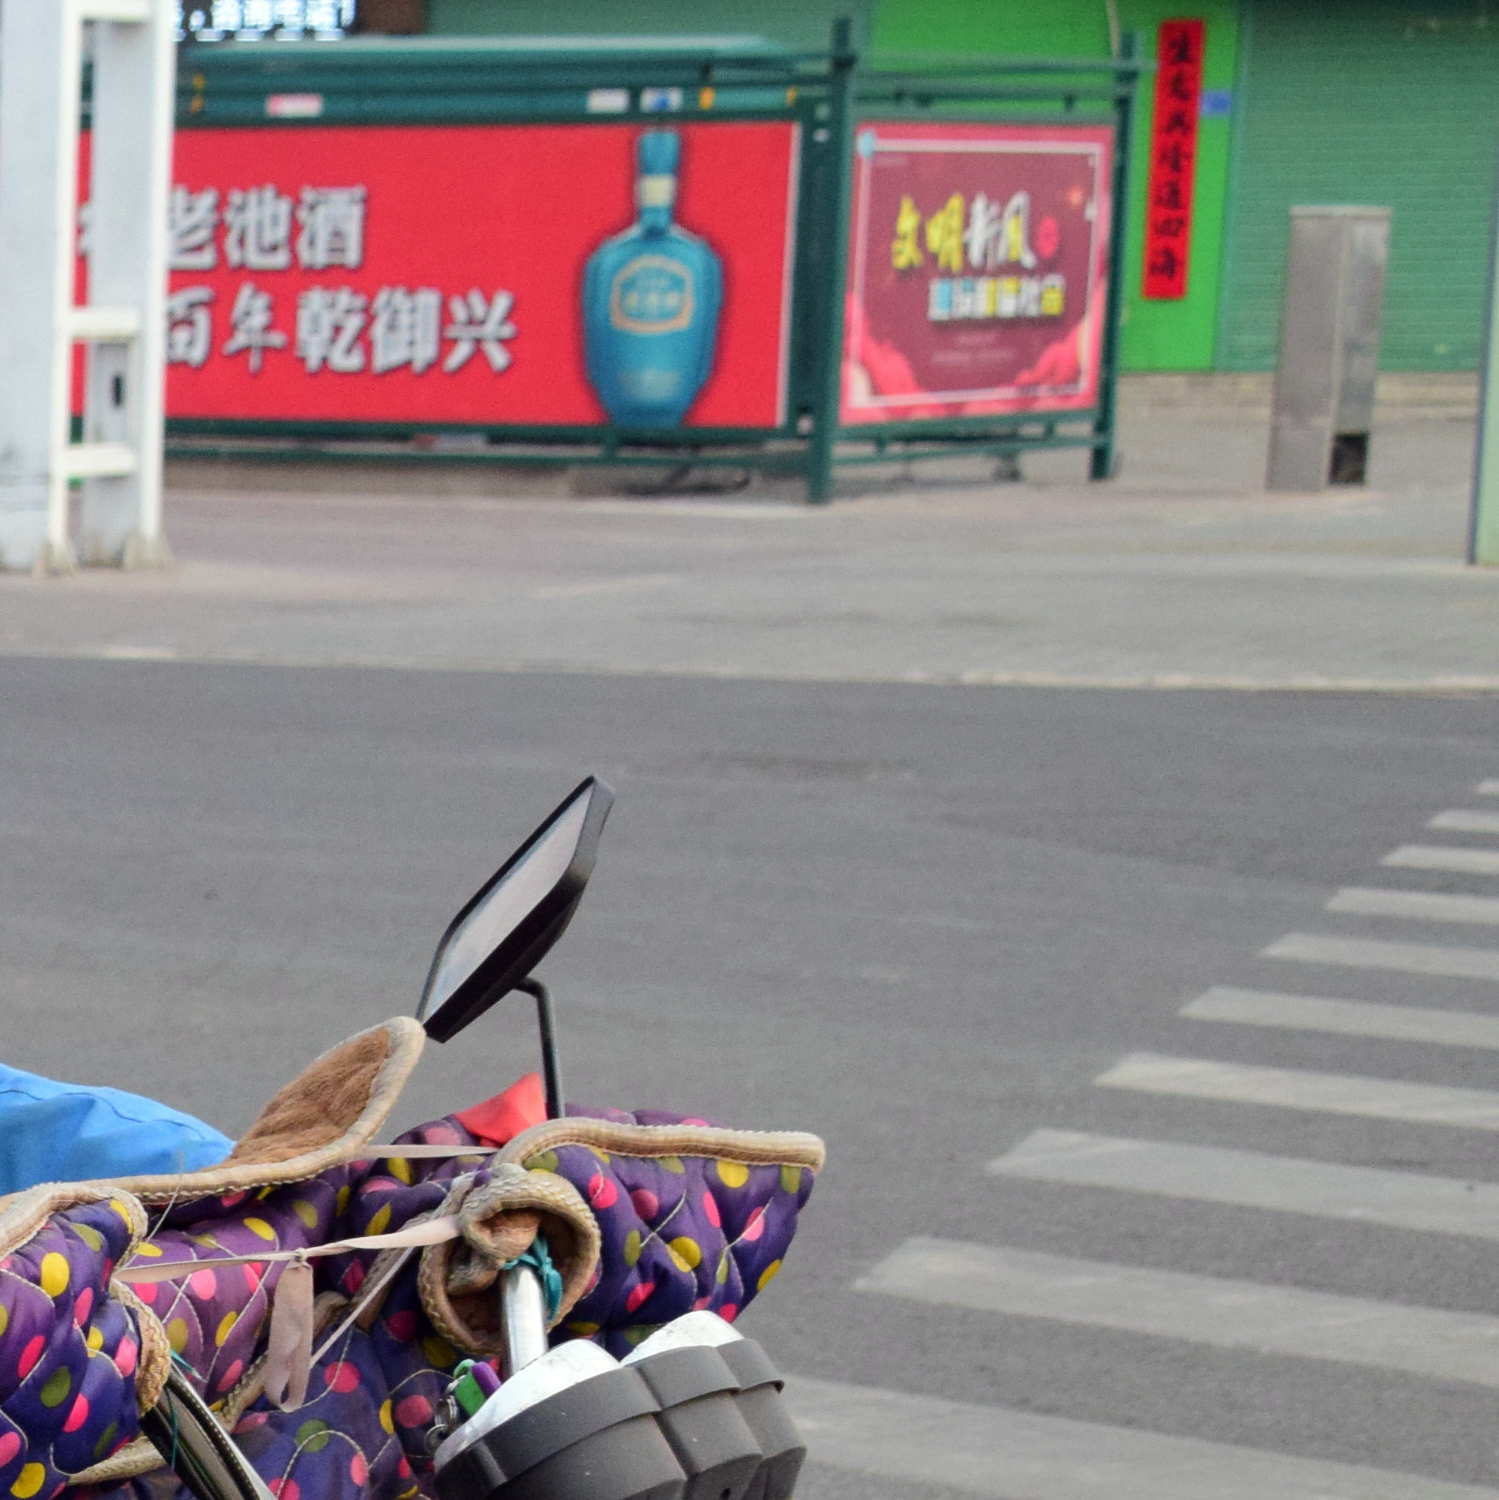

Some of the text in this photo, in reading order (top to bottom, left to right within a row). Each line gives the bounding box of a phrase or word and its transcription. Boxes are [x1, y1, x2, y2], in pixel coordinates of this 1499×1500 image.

[78, 184, 367, 271] 老池酒
[891, 190, 1038, 274] 文明新风
